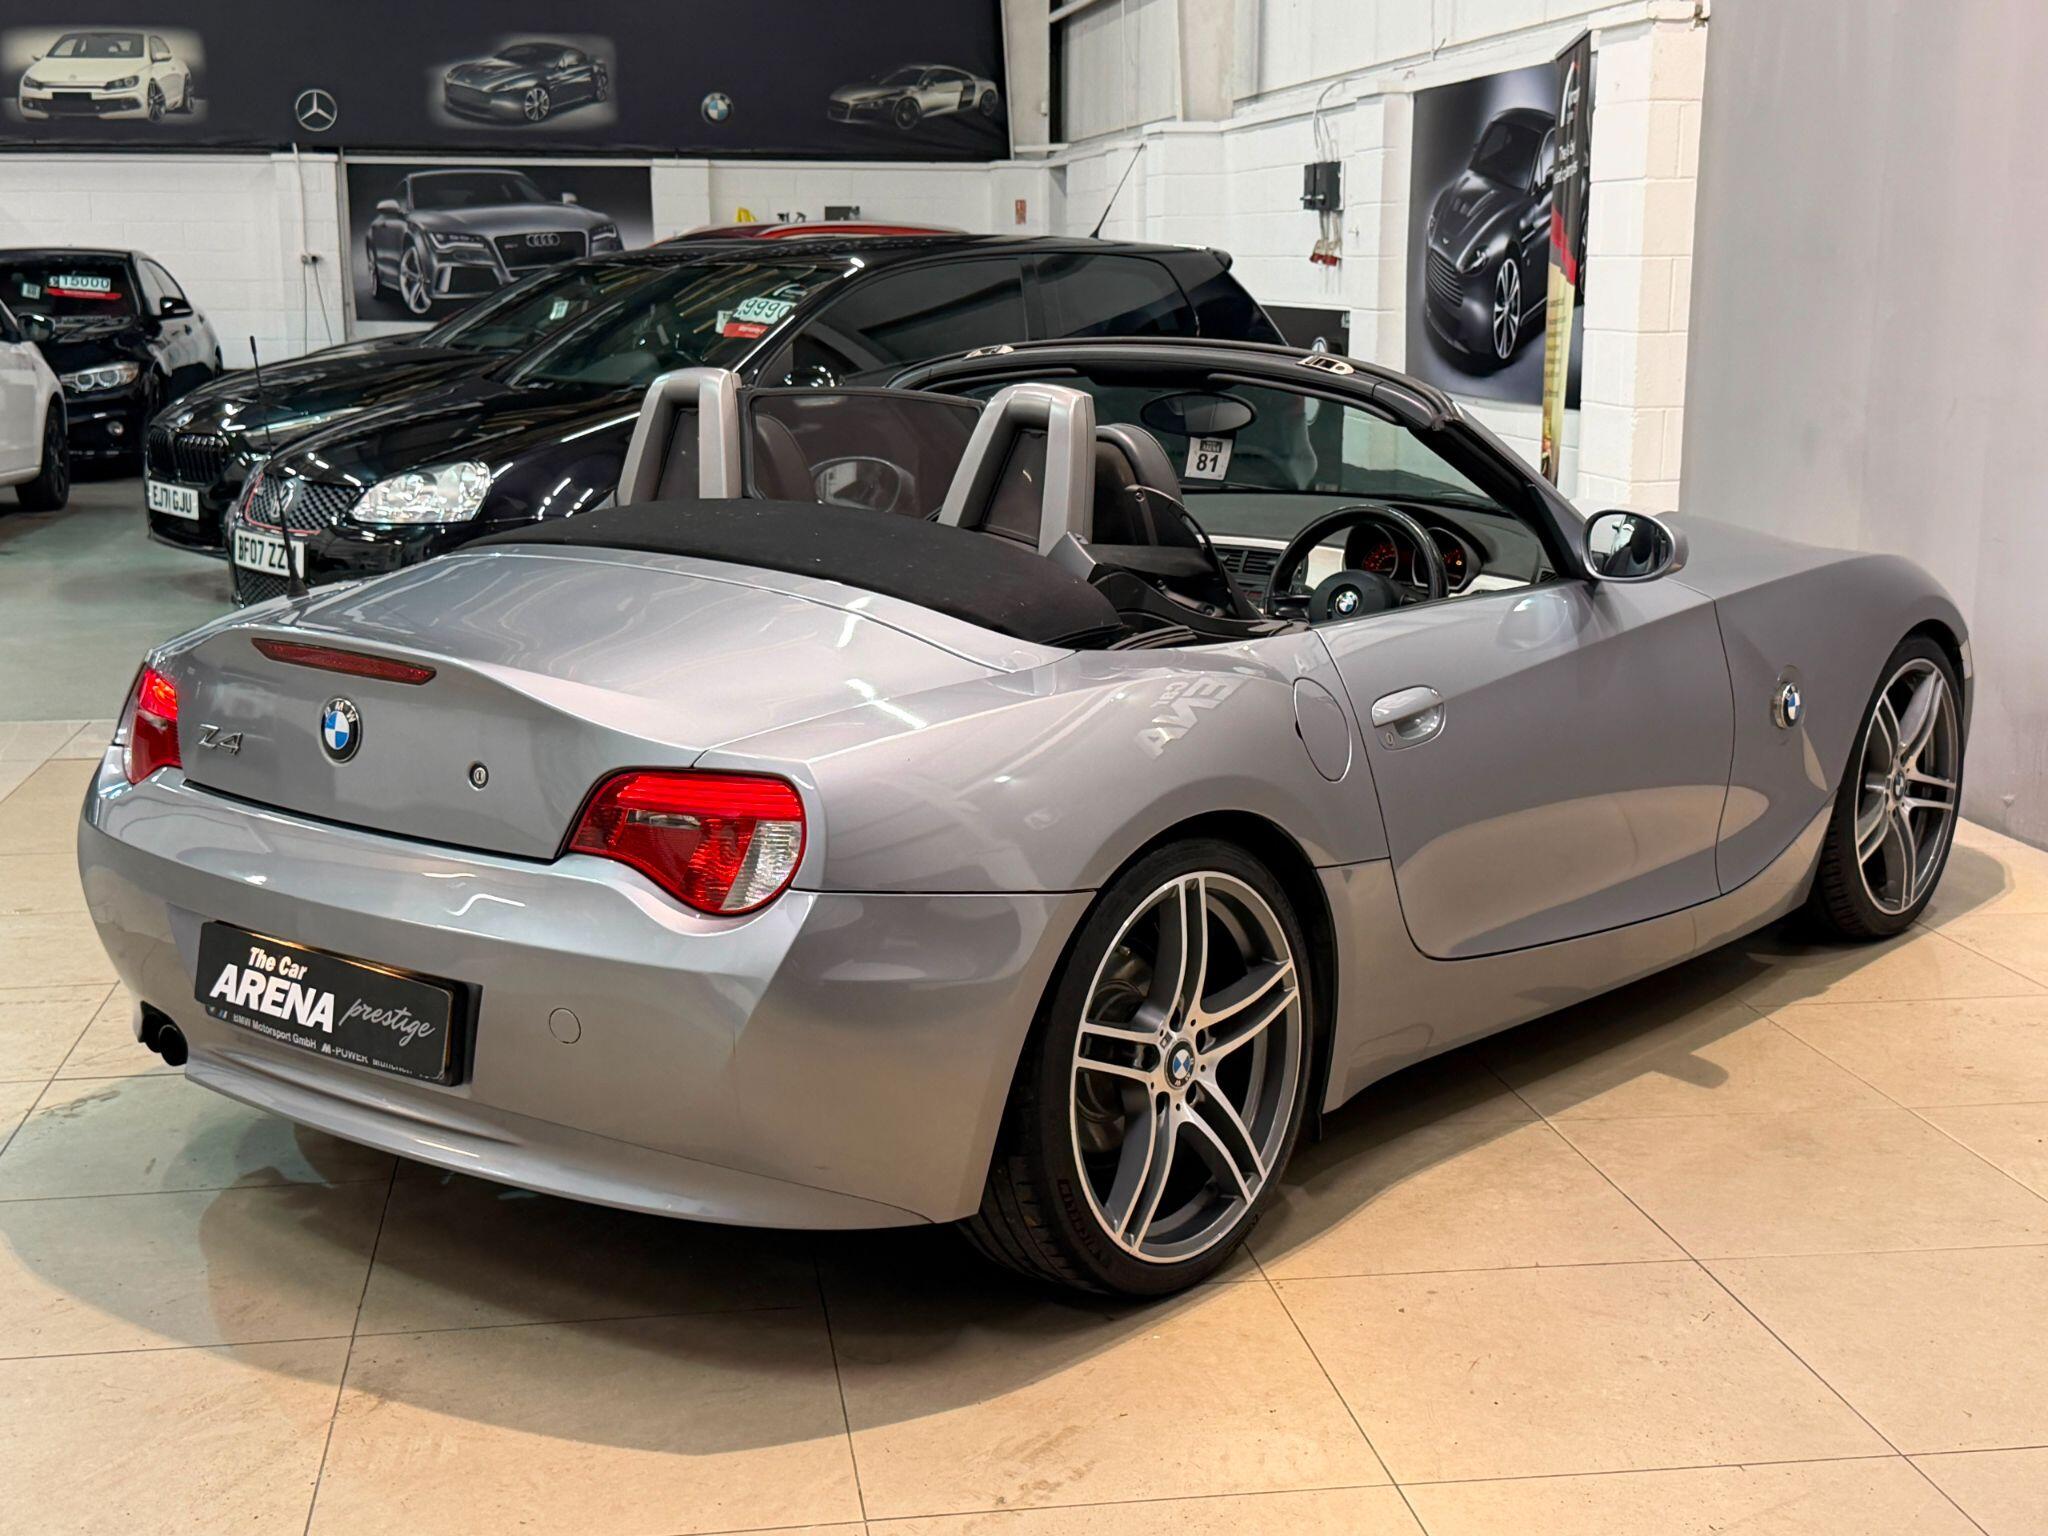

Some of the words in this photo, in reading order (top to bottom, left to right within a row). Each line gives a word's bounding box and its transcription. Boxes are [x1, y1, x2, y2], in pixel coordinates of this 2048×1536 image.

[1196, 453, 1219, 472] 81
[172, 490, 192, 514] GJU
[239, 535, 265, 565] BF07
[199, 723, 243, 756] Z4
[248, 946, 276, 972] The
[279, 956, 308, 981] Car
[209, 963, 335, 1033] ARENA
[339, 998, 436, 1047] prestige
[252, 1020, 291, 1042] Motorsport
[292, 1033, 316, 1049] GmbH
